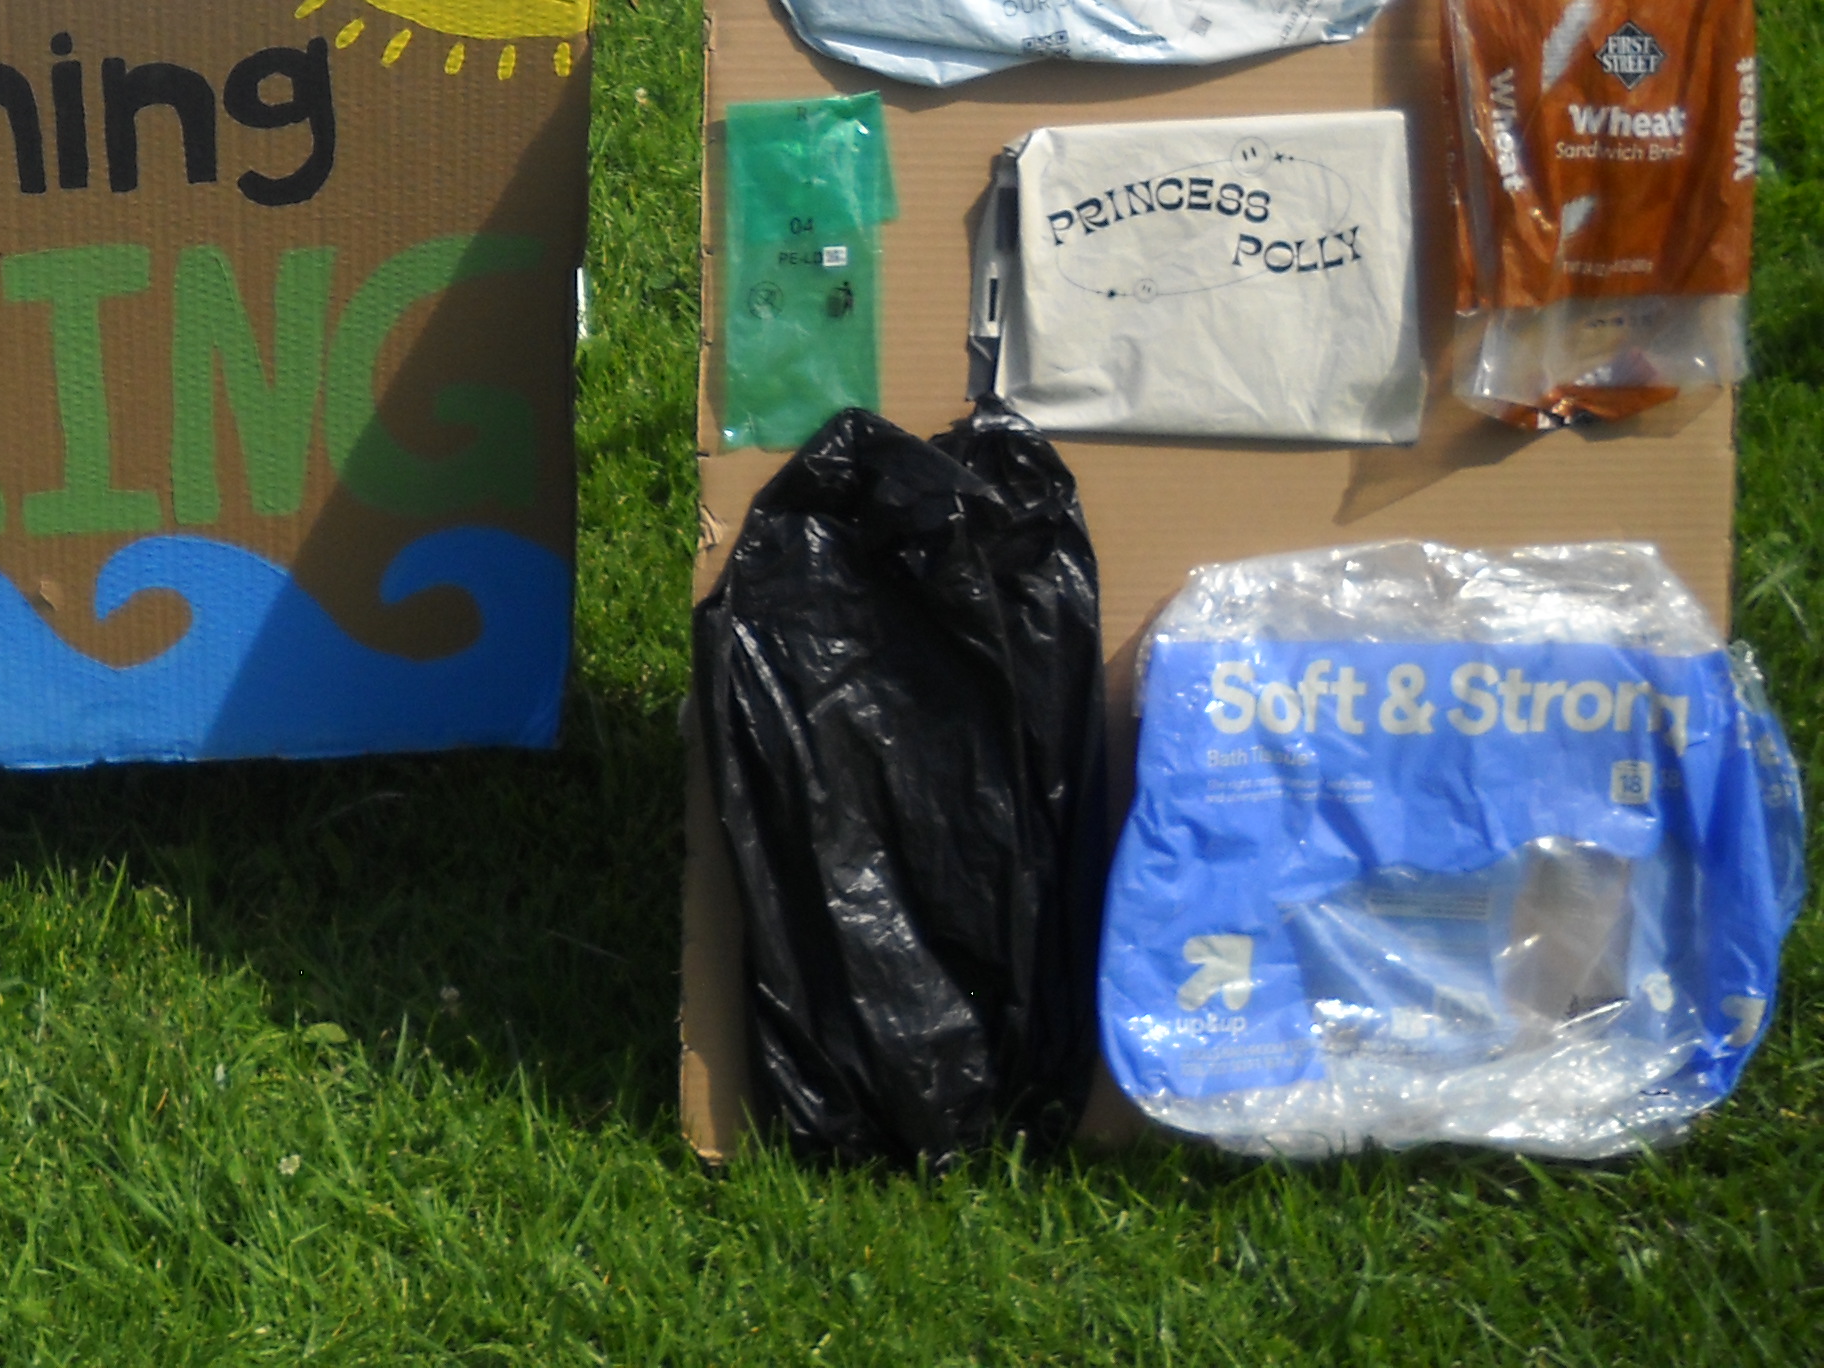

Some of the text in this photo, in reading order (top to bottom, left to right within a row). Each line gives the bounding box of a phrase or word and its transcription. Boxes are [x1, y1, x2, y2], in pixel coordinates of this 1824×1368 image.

[1601, 53, 1659, 74] STREET
[1607, 35, 1654, 55] FIRST
[1490, 67, 1526, 192] Wheat
[1568, 104, 1687, 138] Wheat
[1732, 56, 1756, 181] Wheat
[1555, 140, 1644, 162] Sandwich
[1047, 177, 1272, 246] PRINCESS
[1232, 226, 1363, 274] POLLY
[1208, 660, 1366, 735] Soft
[1379, 662, 1435, 735] &
